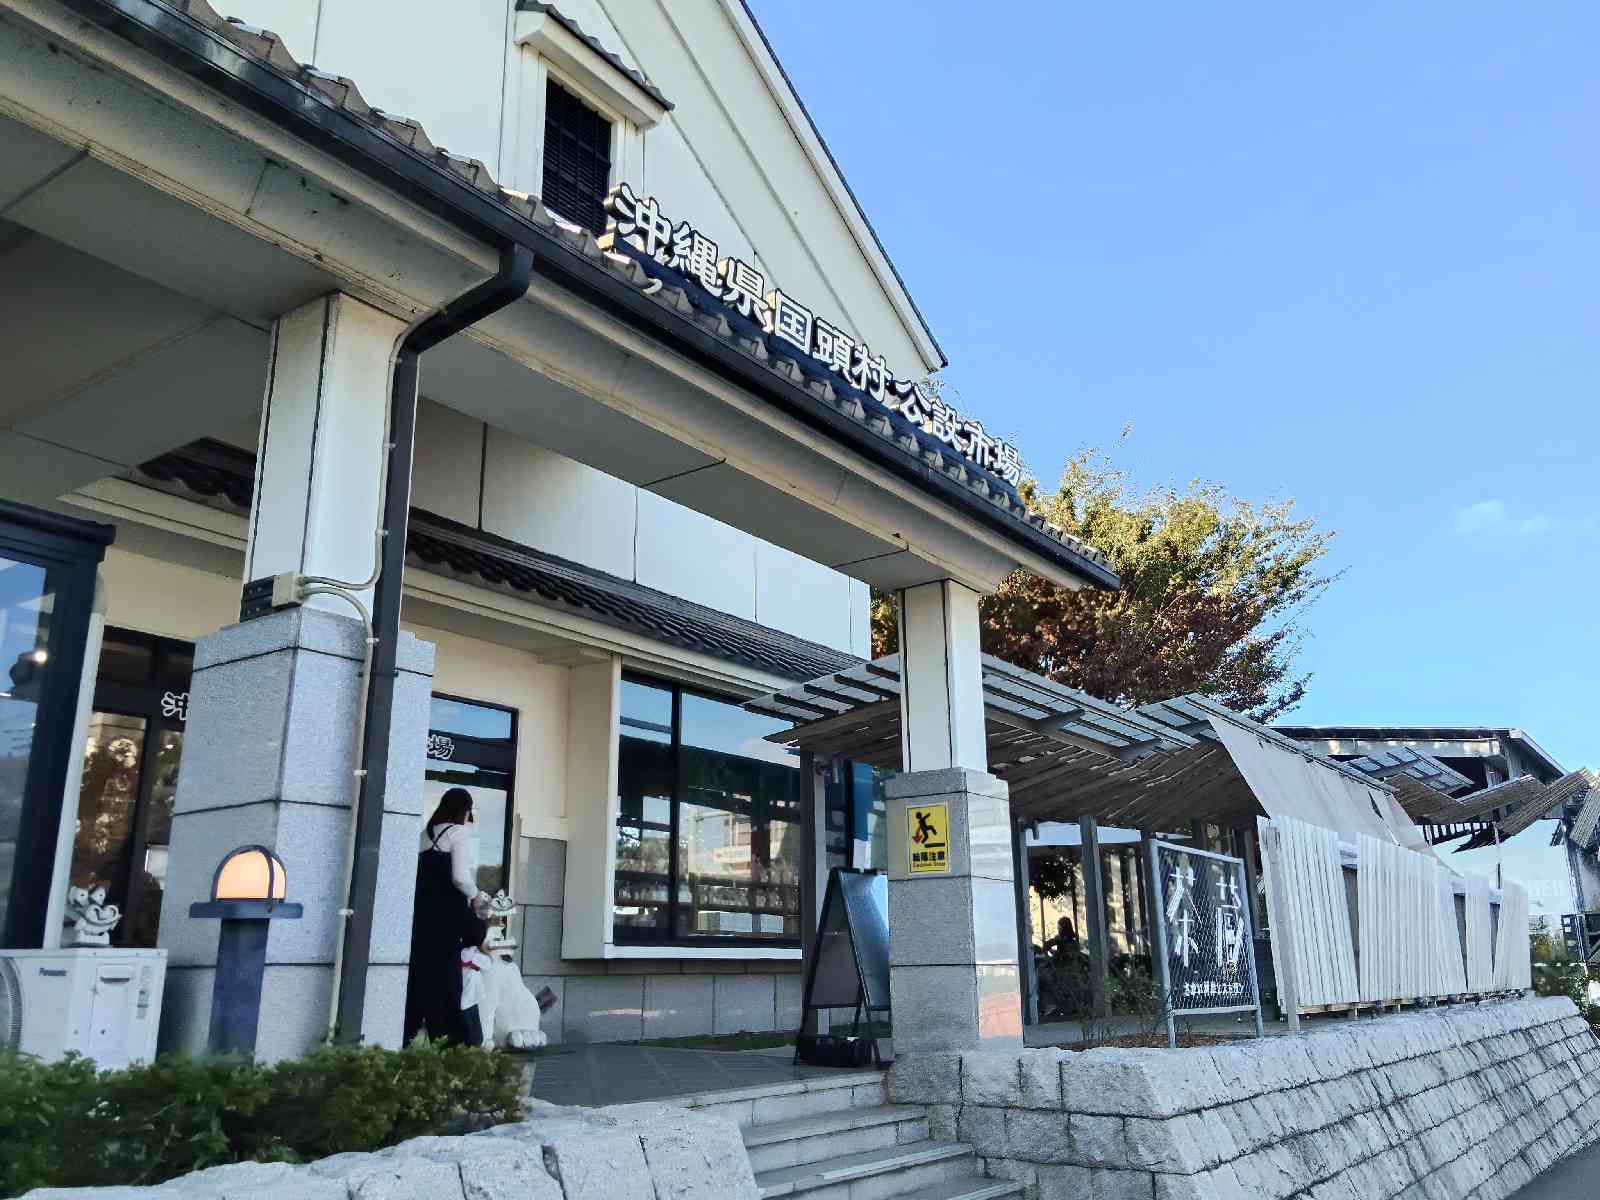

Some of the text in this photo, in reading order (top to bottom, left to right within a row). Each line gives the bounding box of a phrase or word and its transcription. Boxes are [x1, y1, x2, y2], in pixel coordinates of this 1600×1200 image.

[606, 183, 1022, 486] 沖縄県国頭村公設市場
